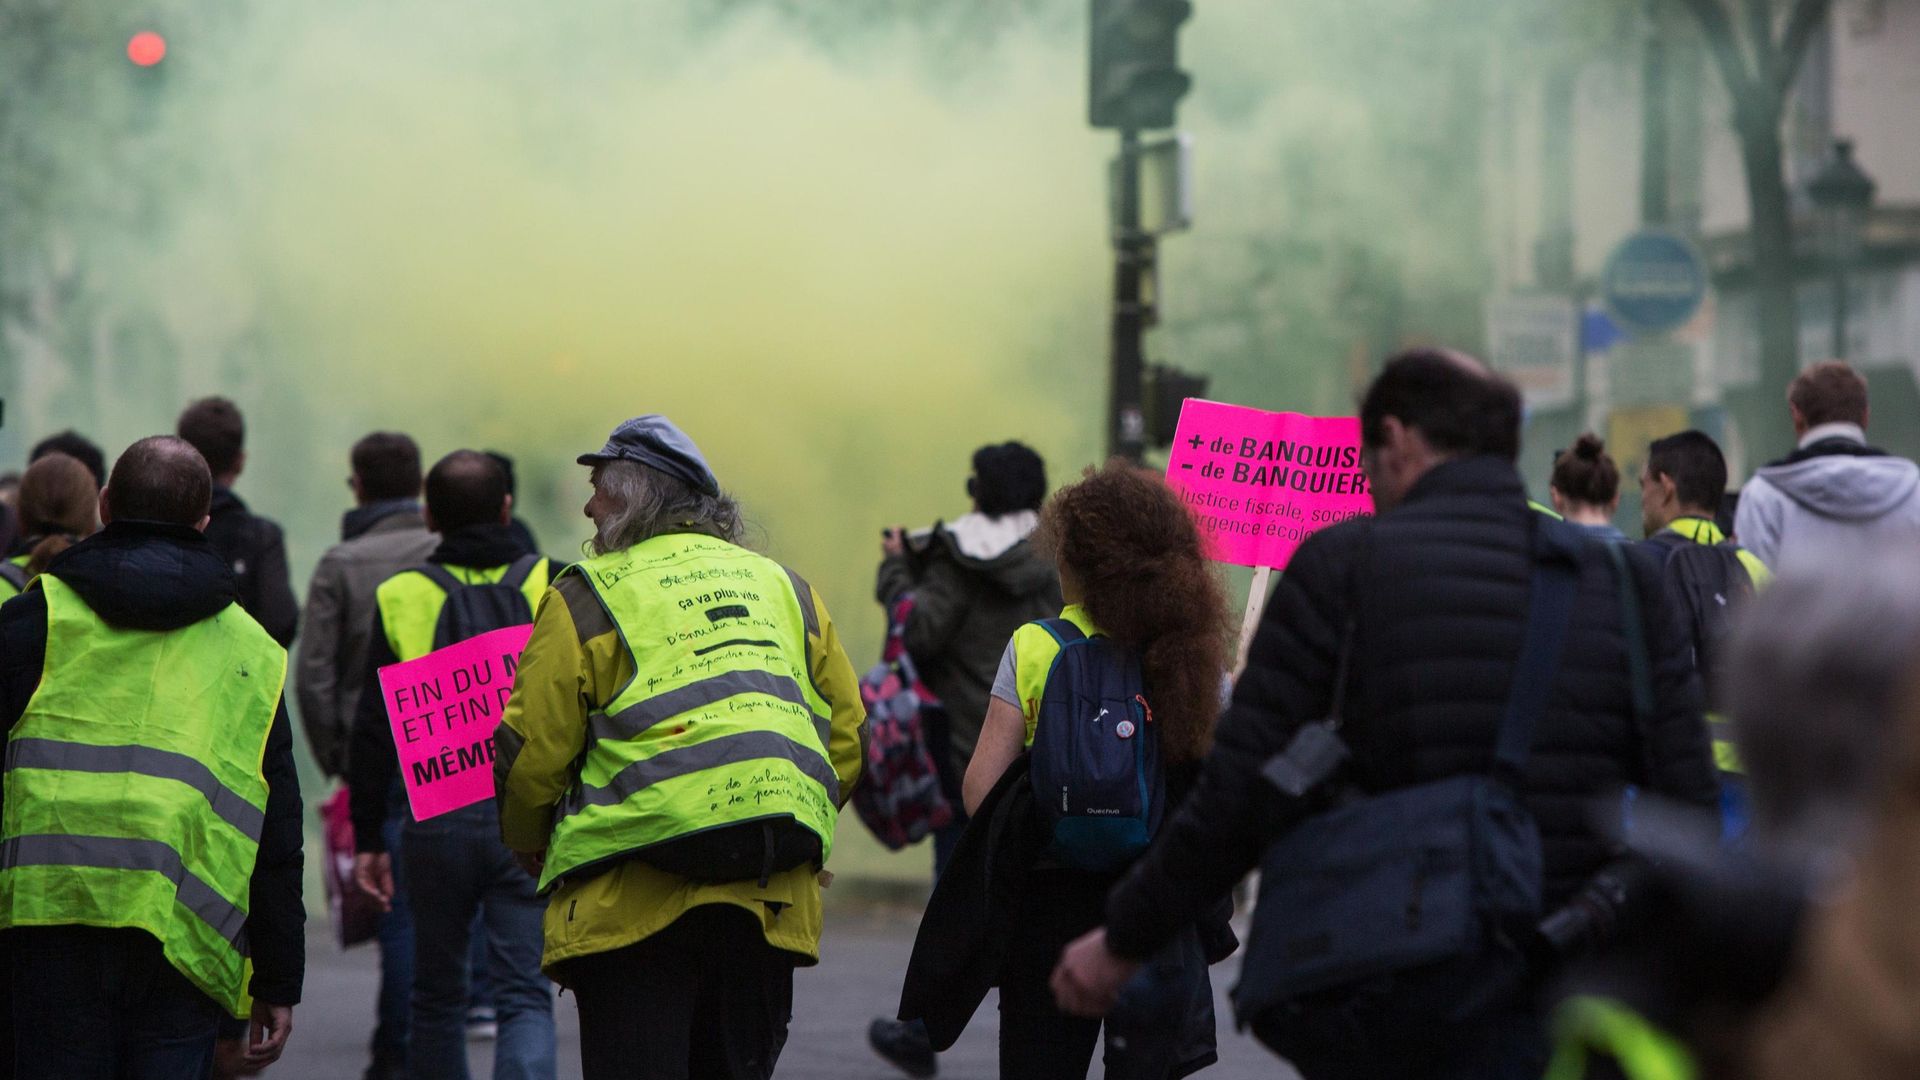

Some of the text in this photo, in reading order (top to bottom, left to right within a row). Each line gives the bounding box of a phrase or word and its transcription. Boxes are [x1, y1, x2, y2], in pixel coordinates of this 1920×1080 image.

[1210, 436, 1234, 454] de
[1200, 461, 1225, 479] de
[1245, 497, 1304, 523] fiscale,
[678, 588, 760, 611] ça va plus vite
[394, 678, 443, 714] FIN
[453, 660, 492, 694] DU
[402, 711, 435, 744] ET
[444, 693, 491, 730] FIN
[1086, 807, 1120, 815] Quechua
